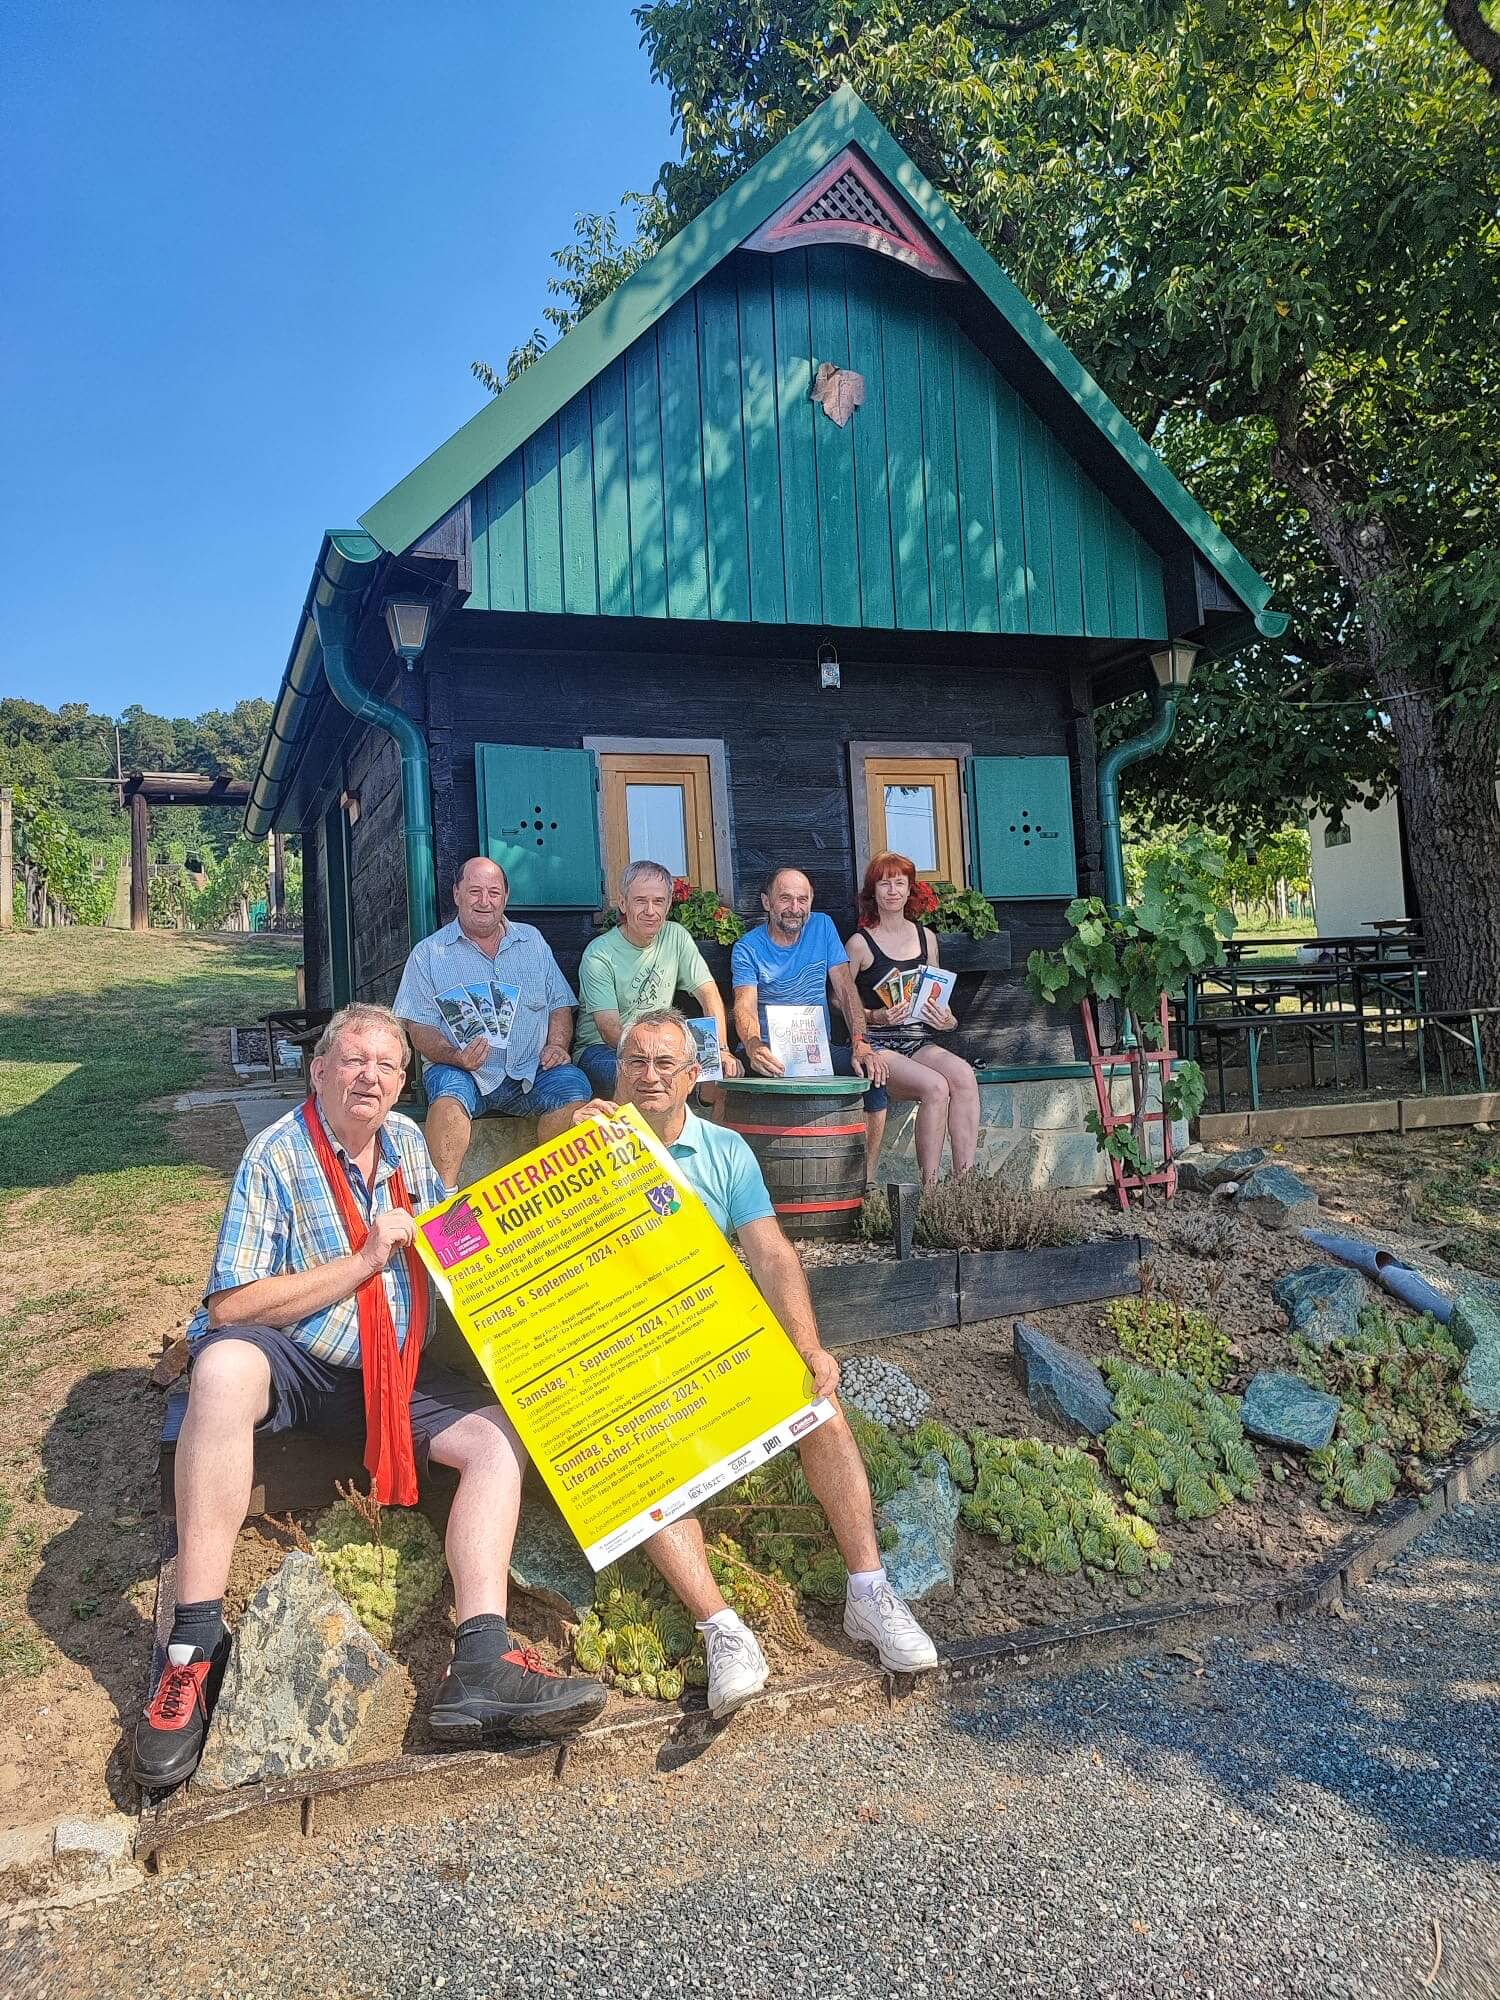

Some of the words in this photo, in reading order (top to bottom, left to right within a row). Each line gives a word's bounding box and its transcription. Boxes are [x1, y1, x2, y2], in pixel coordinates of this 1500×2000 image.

[481, 1113, 637, 1212] LITERATURTAGE
[494, 1160, 607, 1234] KOHFIDISCH
[604, 1135, 650, 1171] 2024
[446, 1258, 485, 1287] Freitag,
[495, 1222, 547, 1259] September
[545, 1214, 562, 1228] bis
[560, 1191, 602, 1221] Sonntag,
[611, 1158, 660, 1191] September
[482, 1251, 527, 1281] Literaturtage
[510, 1268, 519, 1278] 12
[519, 1260, 533, 1272] und
[532, 1254, 545, 1265] der
[472, 1299, 517, 1333] Freitag,
[527, 1259, 586, 1301] September
[584, 1242, 616, 1267] 2024,
[615, 1225, 645, 1248] 19:00
[644, 1213, 664, 1231] Uhr
[515, 1372, 568, 1411] Samstag,
[578, 1330, 637, 1373] September
[635, 1312, 667, 1338] 2024,
[665, 1295, 696, 1319] 17:00
[694, 1283, 715, 1301] Uhr
[553, 1439, 604, 1478] Sonntag,
[602, 1431, 616, 1446] 8.
[614, 1396, 673, 1440] September
[671, 1377, 704, 1404] 2024,
[702, 1359, 733, 1383] 11:00
[731, 1346, 753, 1365] Uhr
[561, 1393, 708, 1492] Literarischer-Frühschoppen
[762, 1434, 782, 1452] pen
